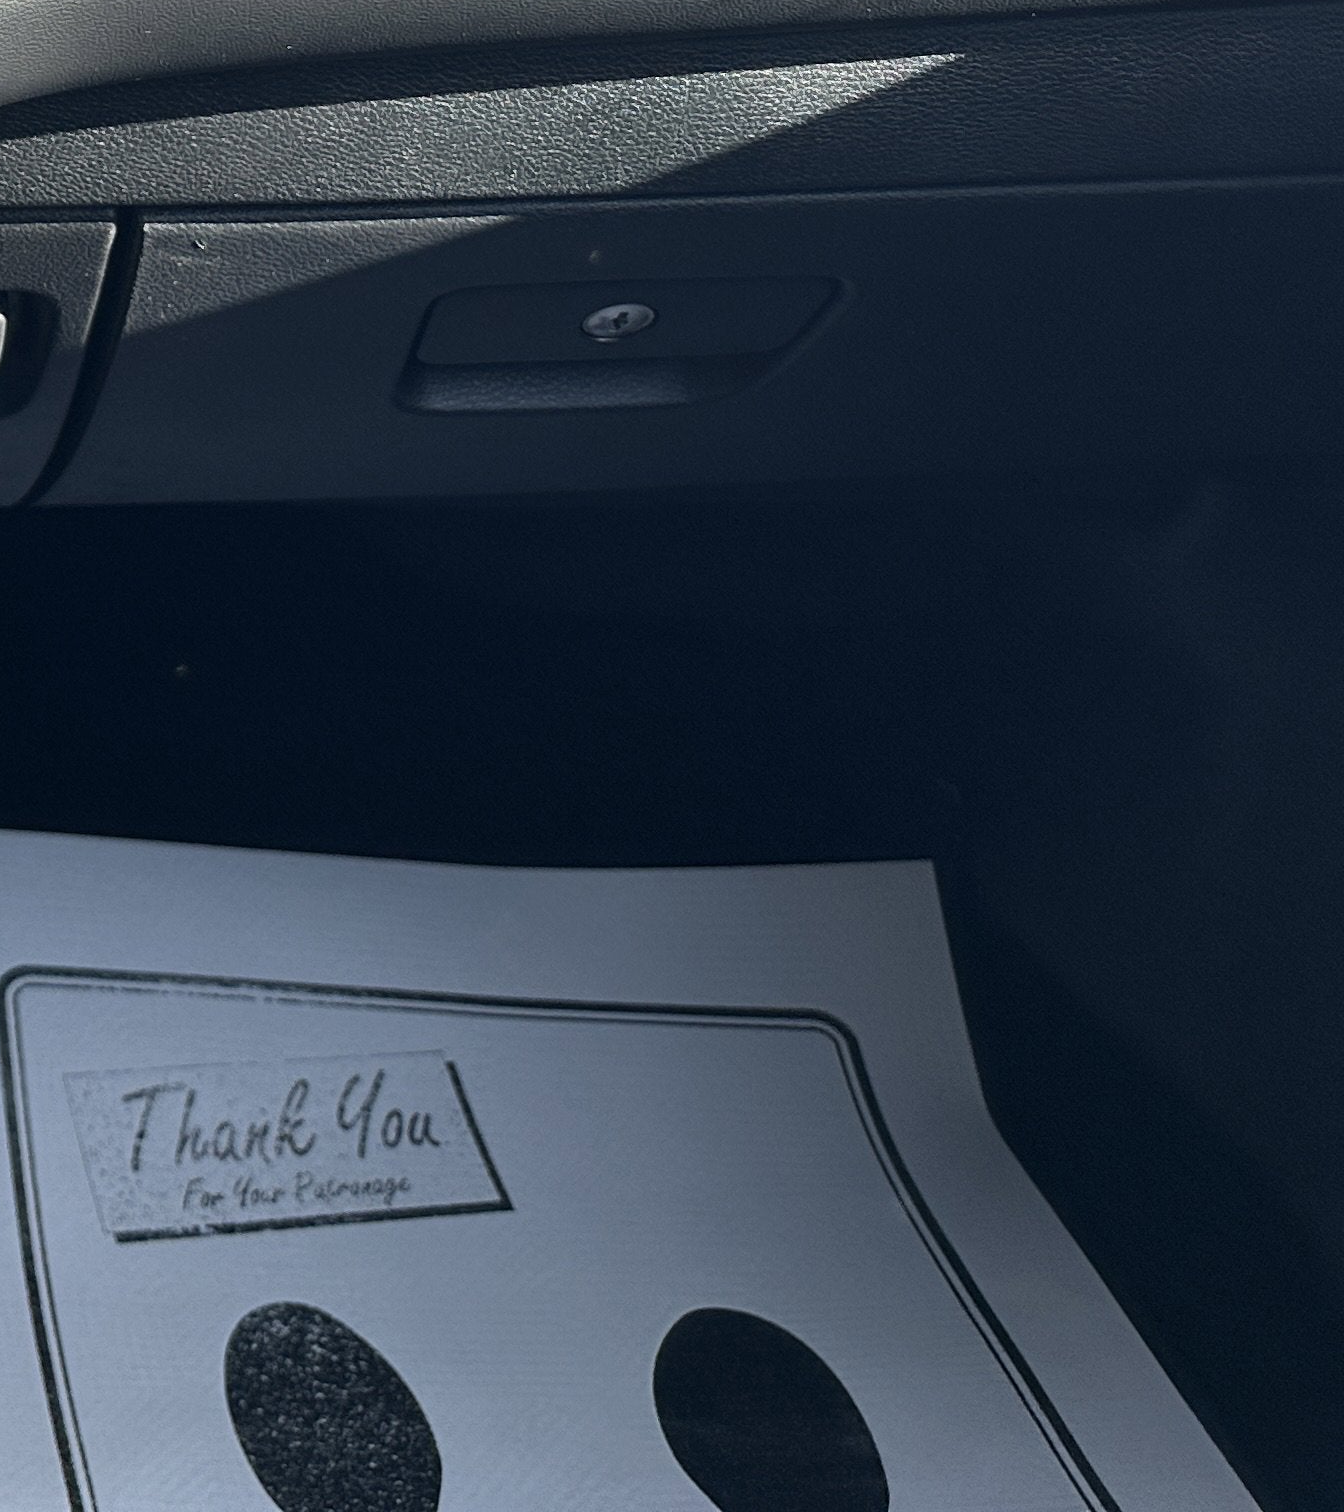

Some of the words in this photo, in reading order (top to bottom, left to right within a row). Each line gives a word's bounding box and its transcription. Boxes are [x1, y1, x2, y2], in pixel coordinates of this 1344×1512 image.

[121, 1078, 314, 1172] Thank
[335, 1068, 441, 1159] You
[182, 1176, 224, 1211] For
[233, 1176, 286, 1209] Your
[295, 1170, 411, 1207] Patronage
